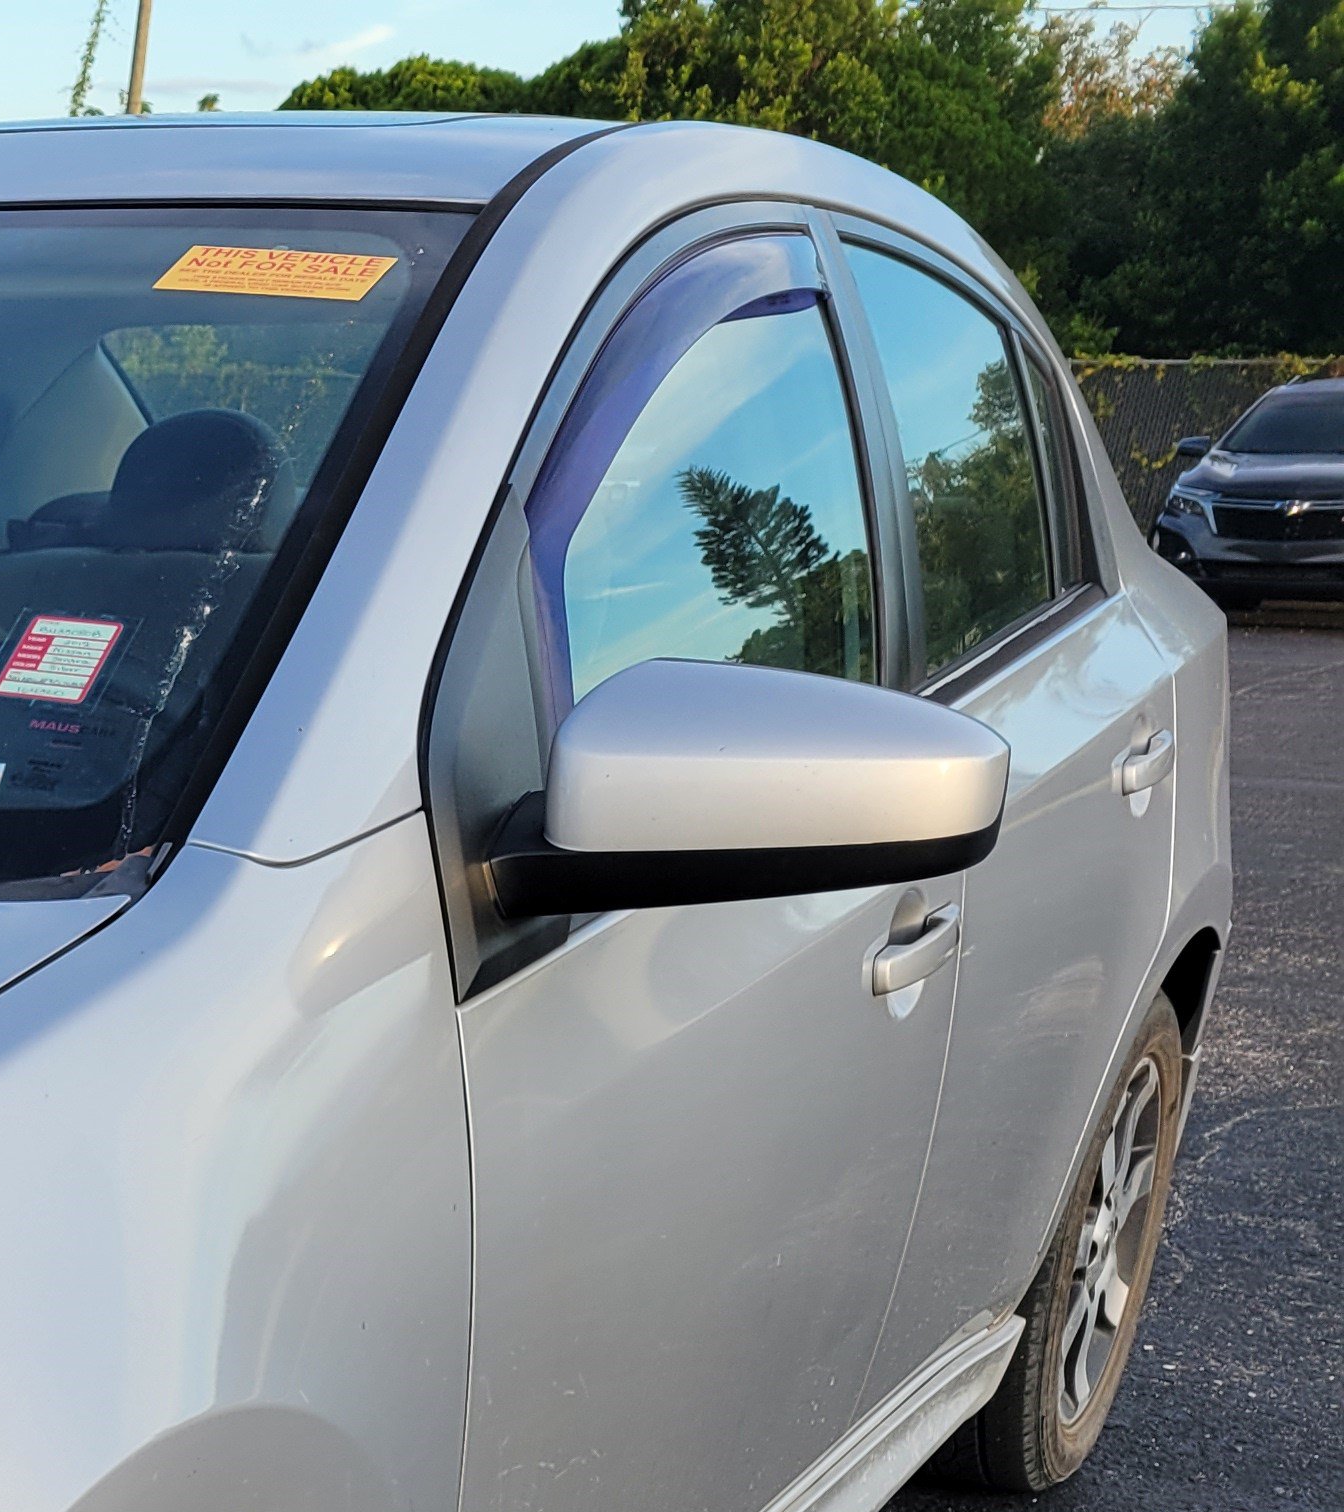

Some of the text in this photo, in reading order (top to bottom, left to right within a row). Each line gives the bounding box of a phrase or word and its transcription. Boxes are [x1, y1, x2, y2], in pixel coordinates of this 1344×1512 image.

[186, 257, 380, 277] Not FOR SALE
[200, 247, 385, 267] THIS VEHICLE
[29, 719, 81, 734] MAUS
